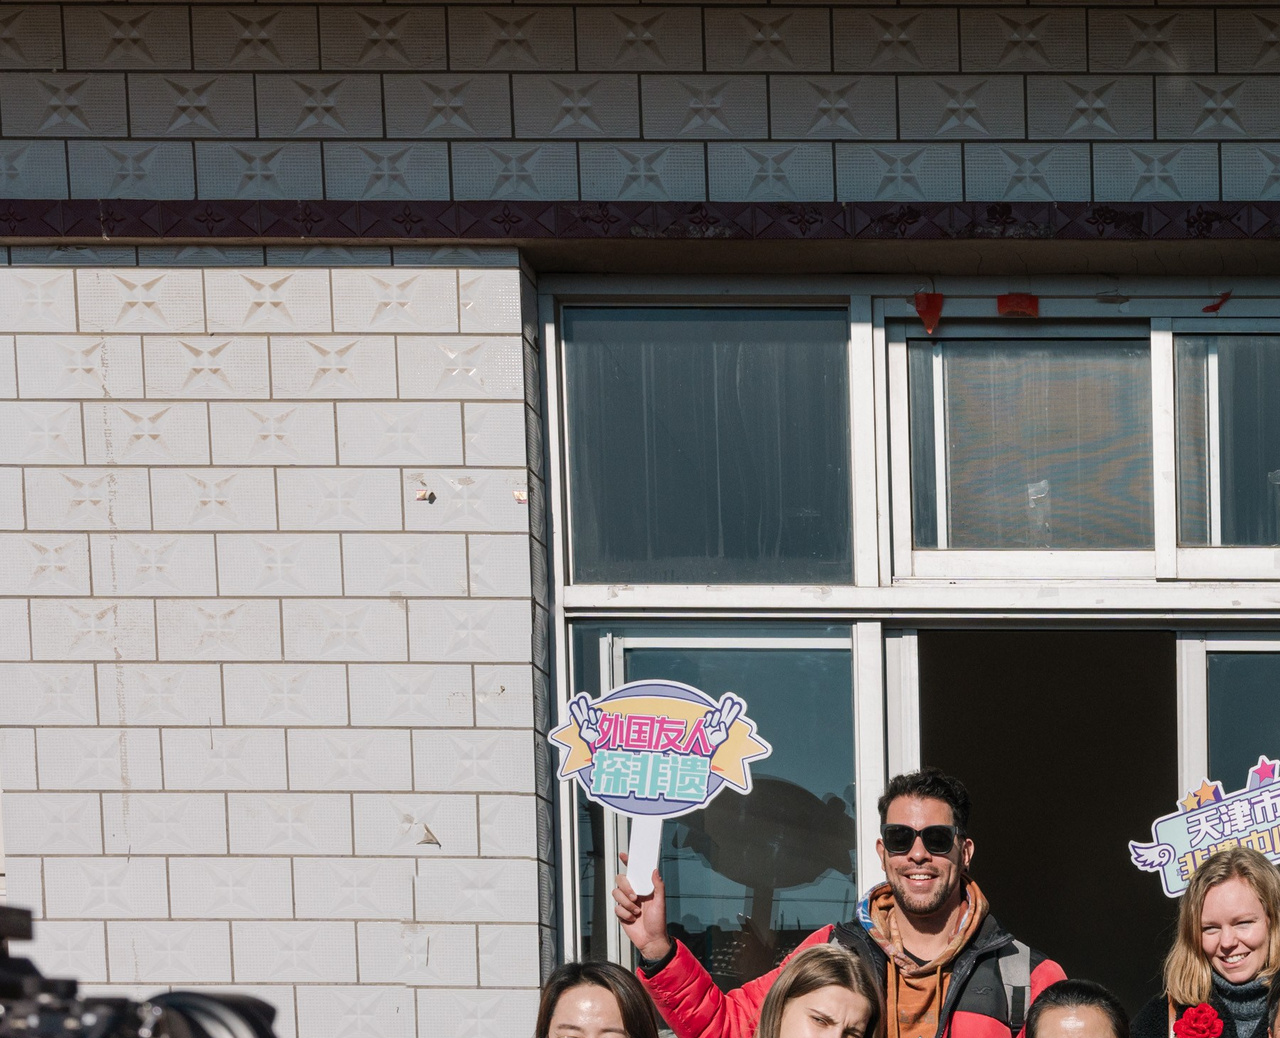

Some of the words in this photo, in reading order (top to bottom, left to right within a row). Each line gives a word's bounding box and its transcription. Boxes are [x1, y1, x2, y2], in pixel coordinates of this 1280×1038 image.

[595, 713, 712, 755] 外国友人
[592, 750, 711, 799] 探非遗
